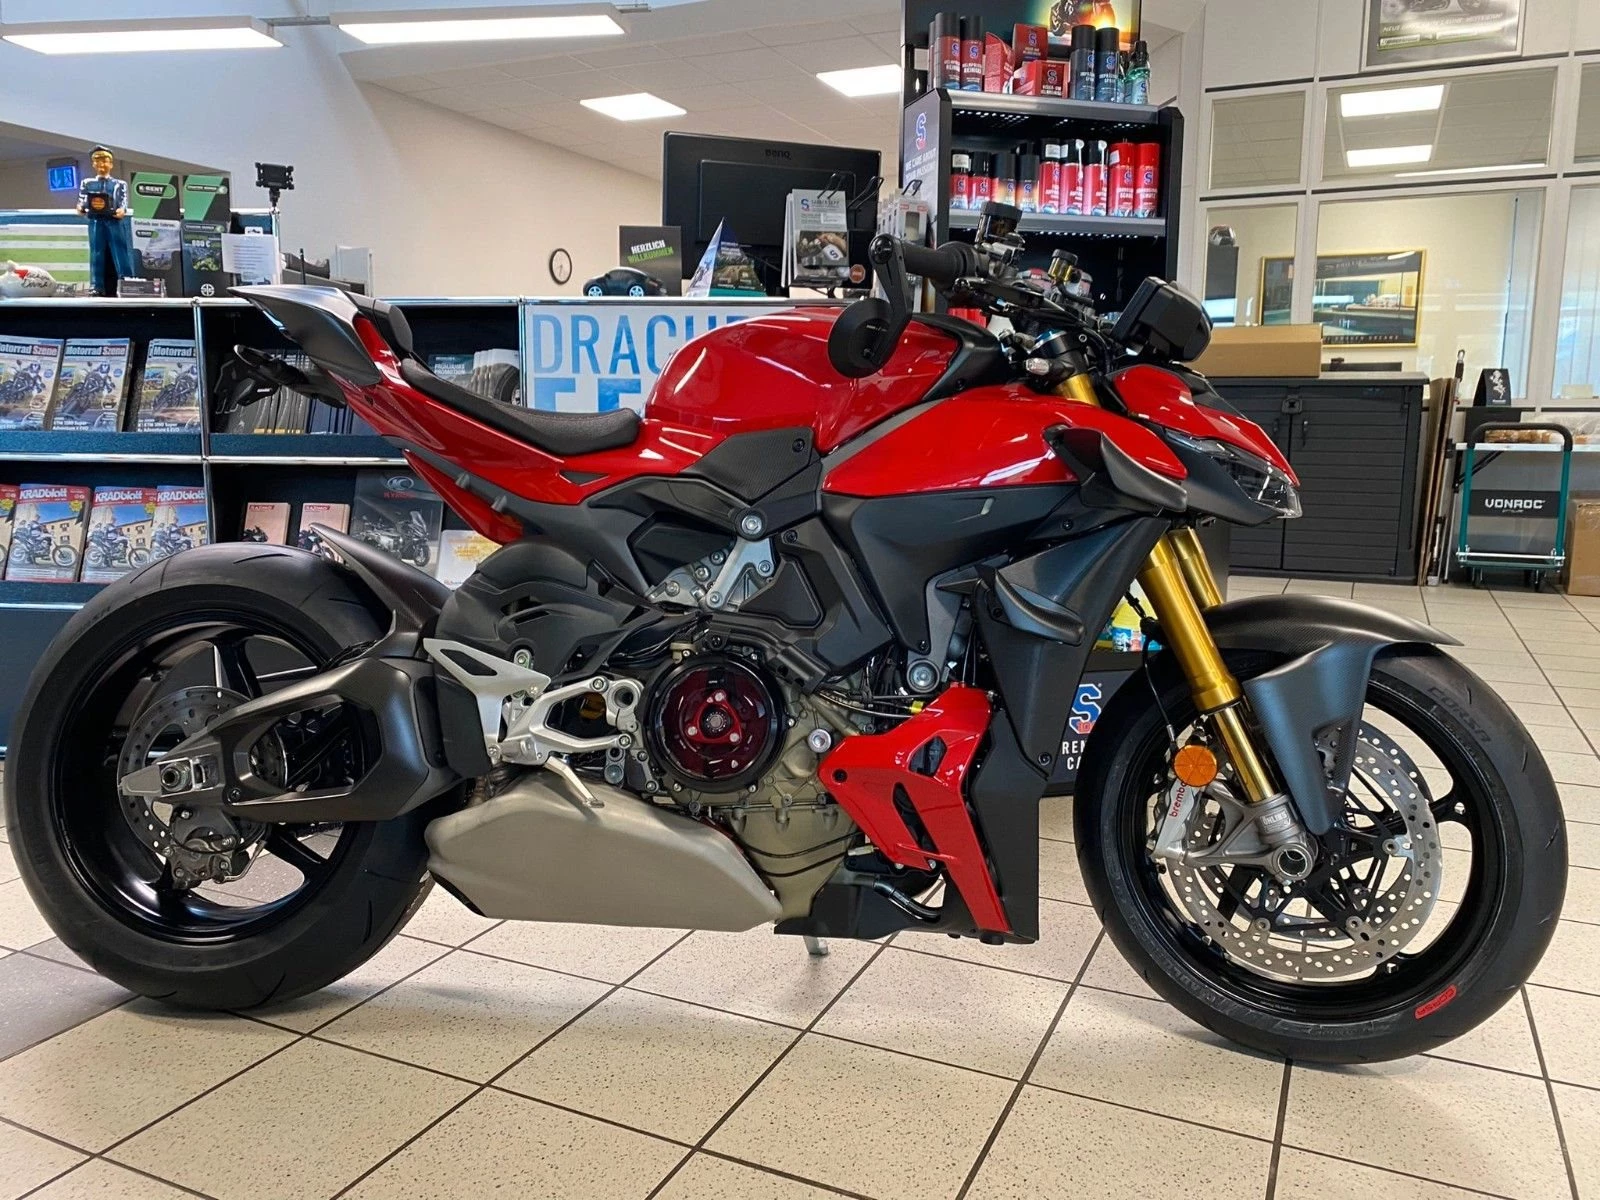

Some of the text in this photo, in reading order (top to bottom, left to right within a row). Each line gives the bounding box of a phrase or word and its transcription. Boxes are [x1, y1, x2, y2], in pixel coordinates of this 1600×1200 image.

[765, 149, 791, 160] BenQ
[630, 239, 666, 255] HERZLICH
[627, 247, 674, 264] WILLKOMMEN
[0, 342, 57, 356] otorrad Szene
[66, 344, 126, 355] Motorrad Szene
[153, 345, 191, 356] Motorrad
[532, 314, 749, 375] DRAC
[19, 488, 68, 499] KRADblatt
[95, 490, 142, 502] KRADblatt
[157, 490, 206, 502] KRADblatt
[1484, 498, 1543, 509] VONROC
[1427, 686, 1491, 742] CORSA
[1169, 781, 1187, 817] brembo
[1417, 988, 1455, 1016] CORSA
